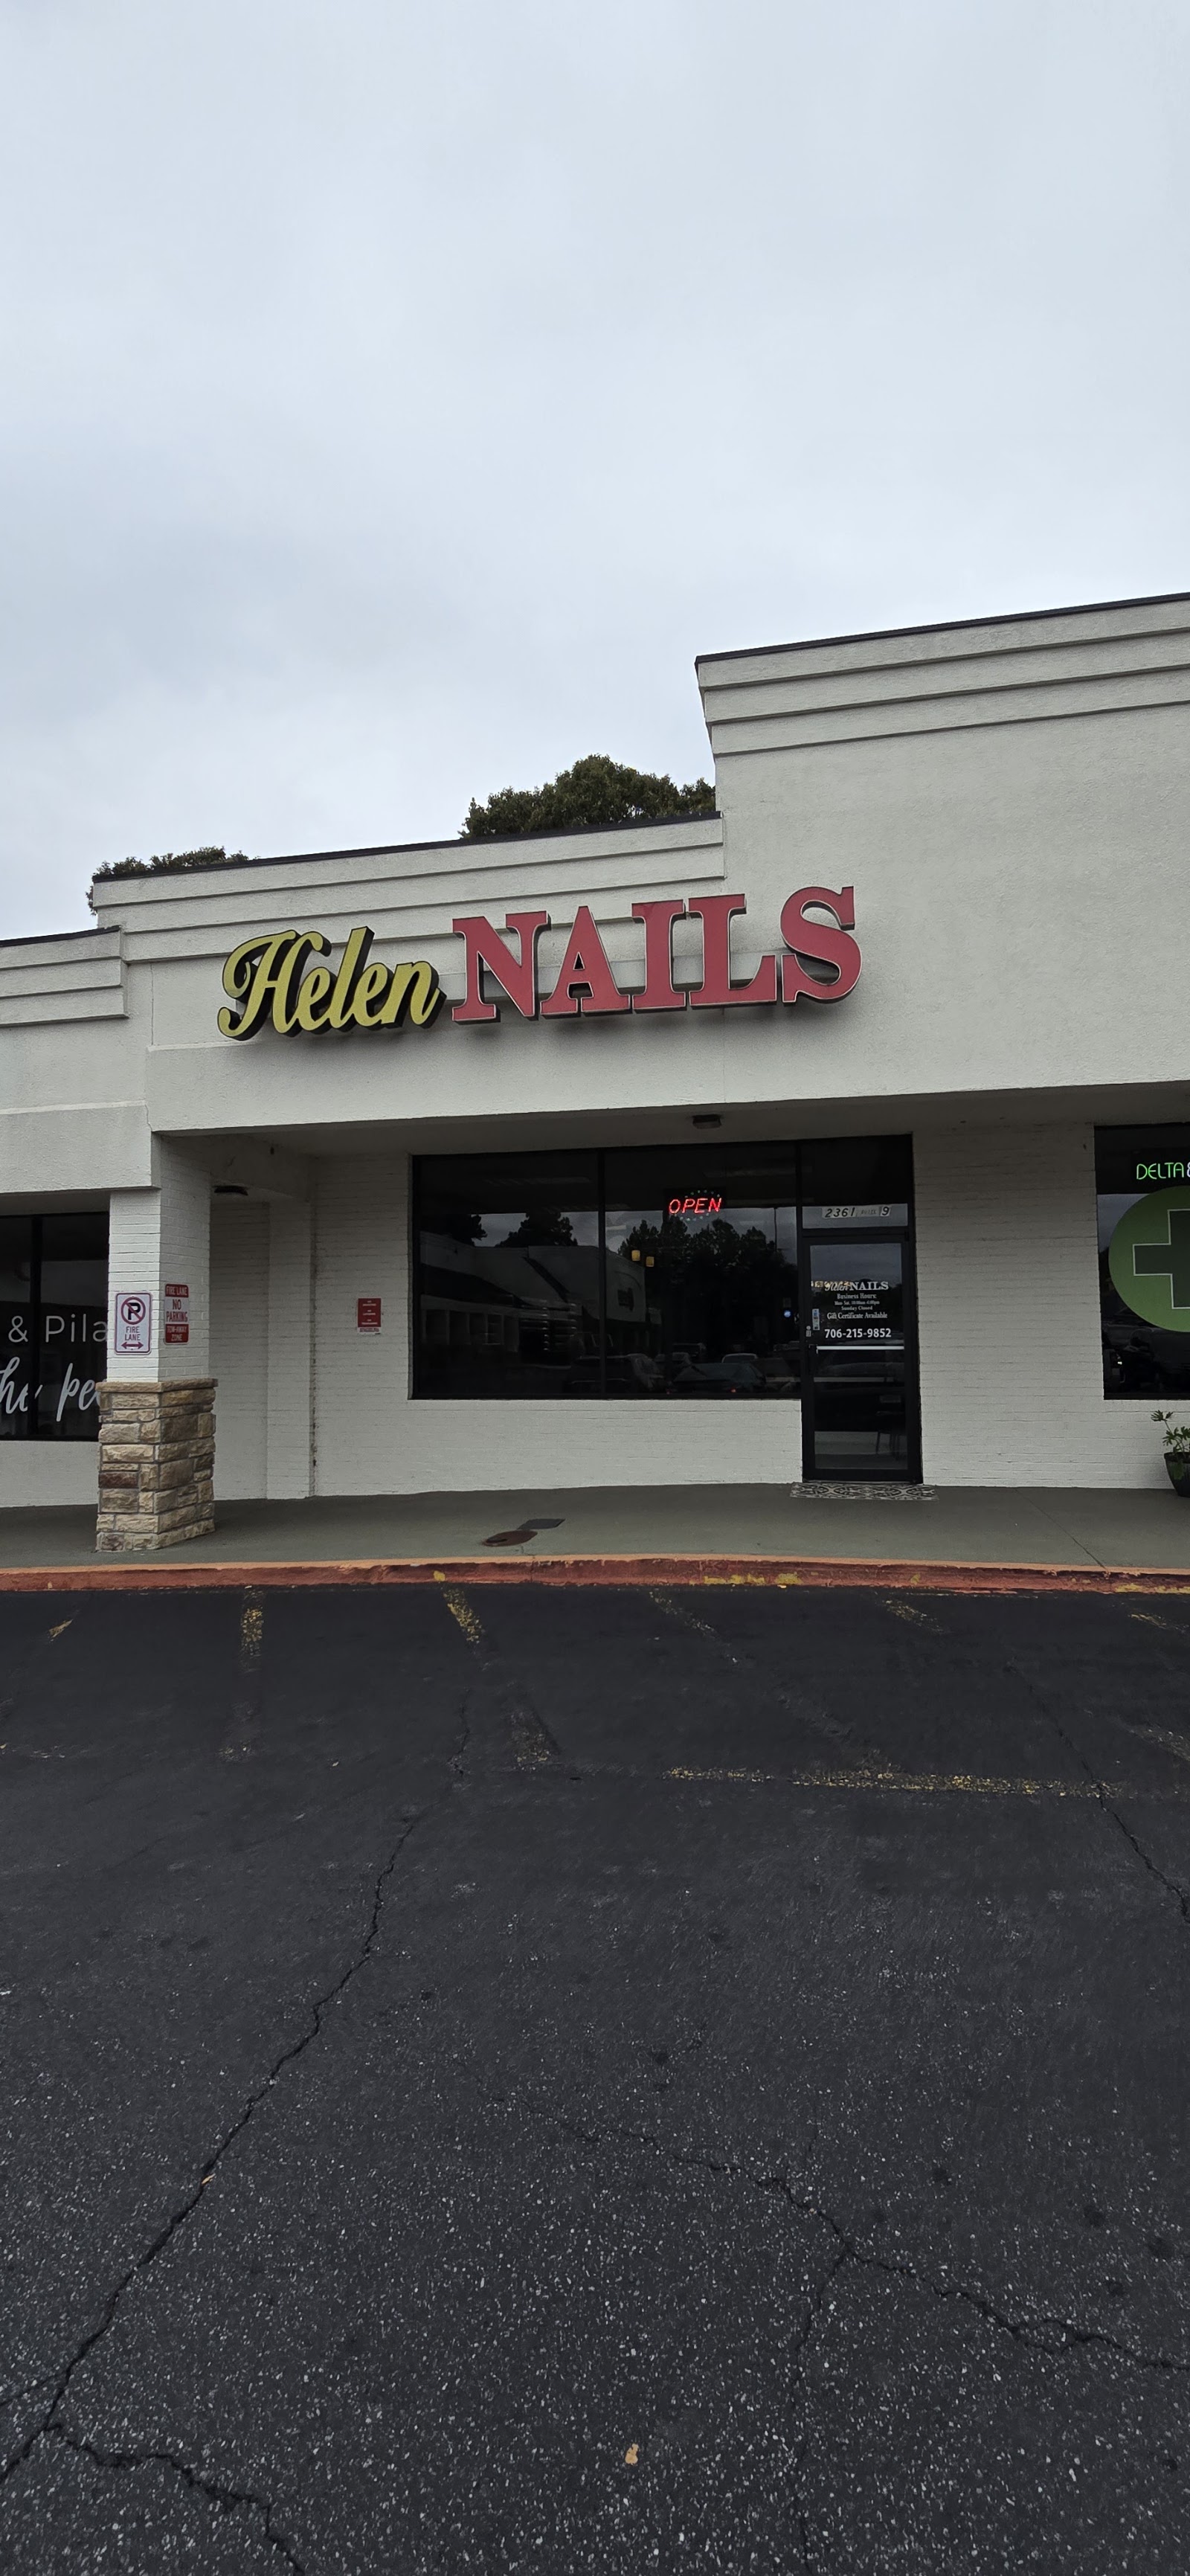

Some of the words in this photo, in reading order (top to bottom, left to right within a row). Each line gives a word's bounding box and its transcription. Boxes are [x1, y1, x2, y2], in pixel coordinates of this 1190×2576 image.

[217, 926, 445, 1039] Helen
[451, 886, 863, 1024] NAILS
[1136, 1162, 1185, 1181] DELTA
[669, 1198, 722, 1214] OPEN
[825, 1207, 855, 1218] 2361
[881, 1206, 890, 1216] 9
[166, 1286, 176, 1295] FIRE
[176, 1287, 187, 1296] LANE
[849, 1281, 890, 1291] NAILS
[172, 1299, 181, 1310] NO
[167, 1311, 188, 1323] PARKING
[8, 1315, 28, 1343] &
[824, 1328, 892, 1338] 706-215-9852
